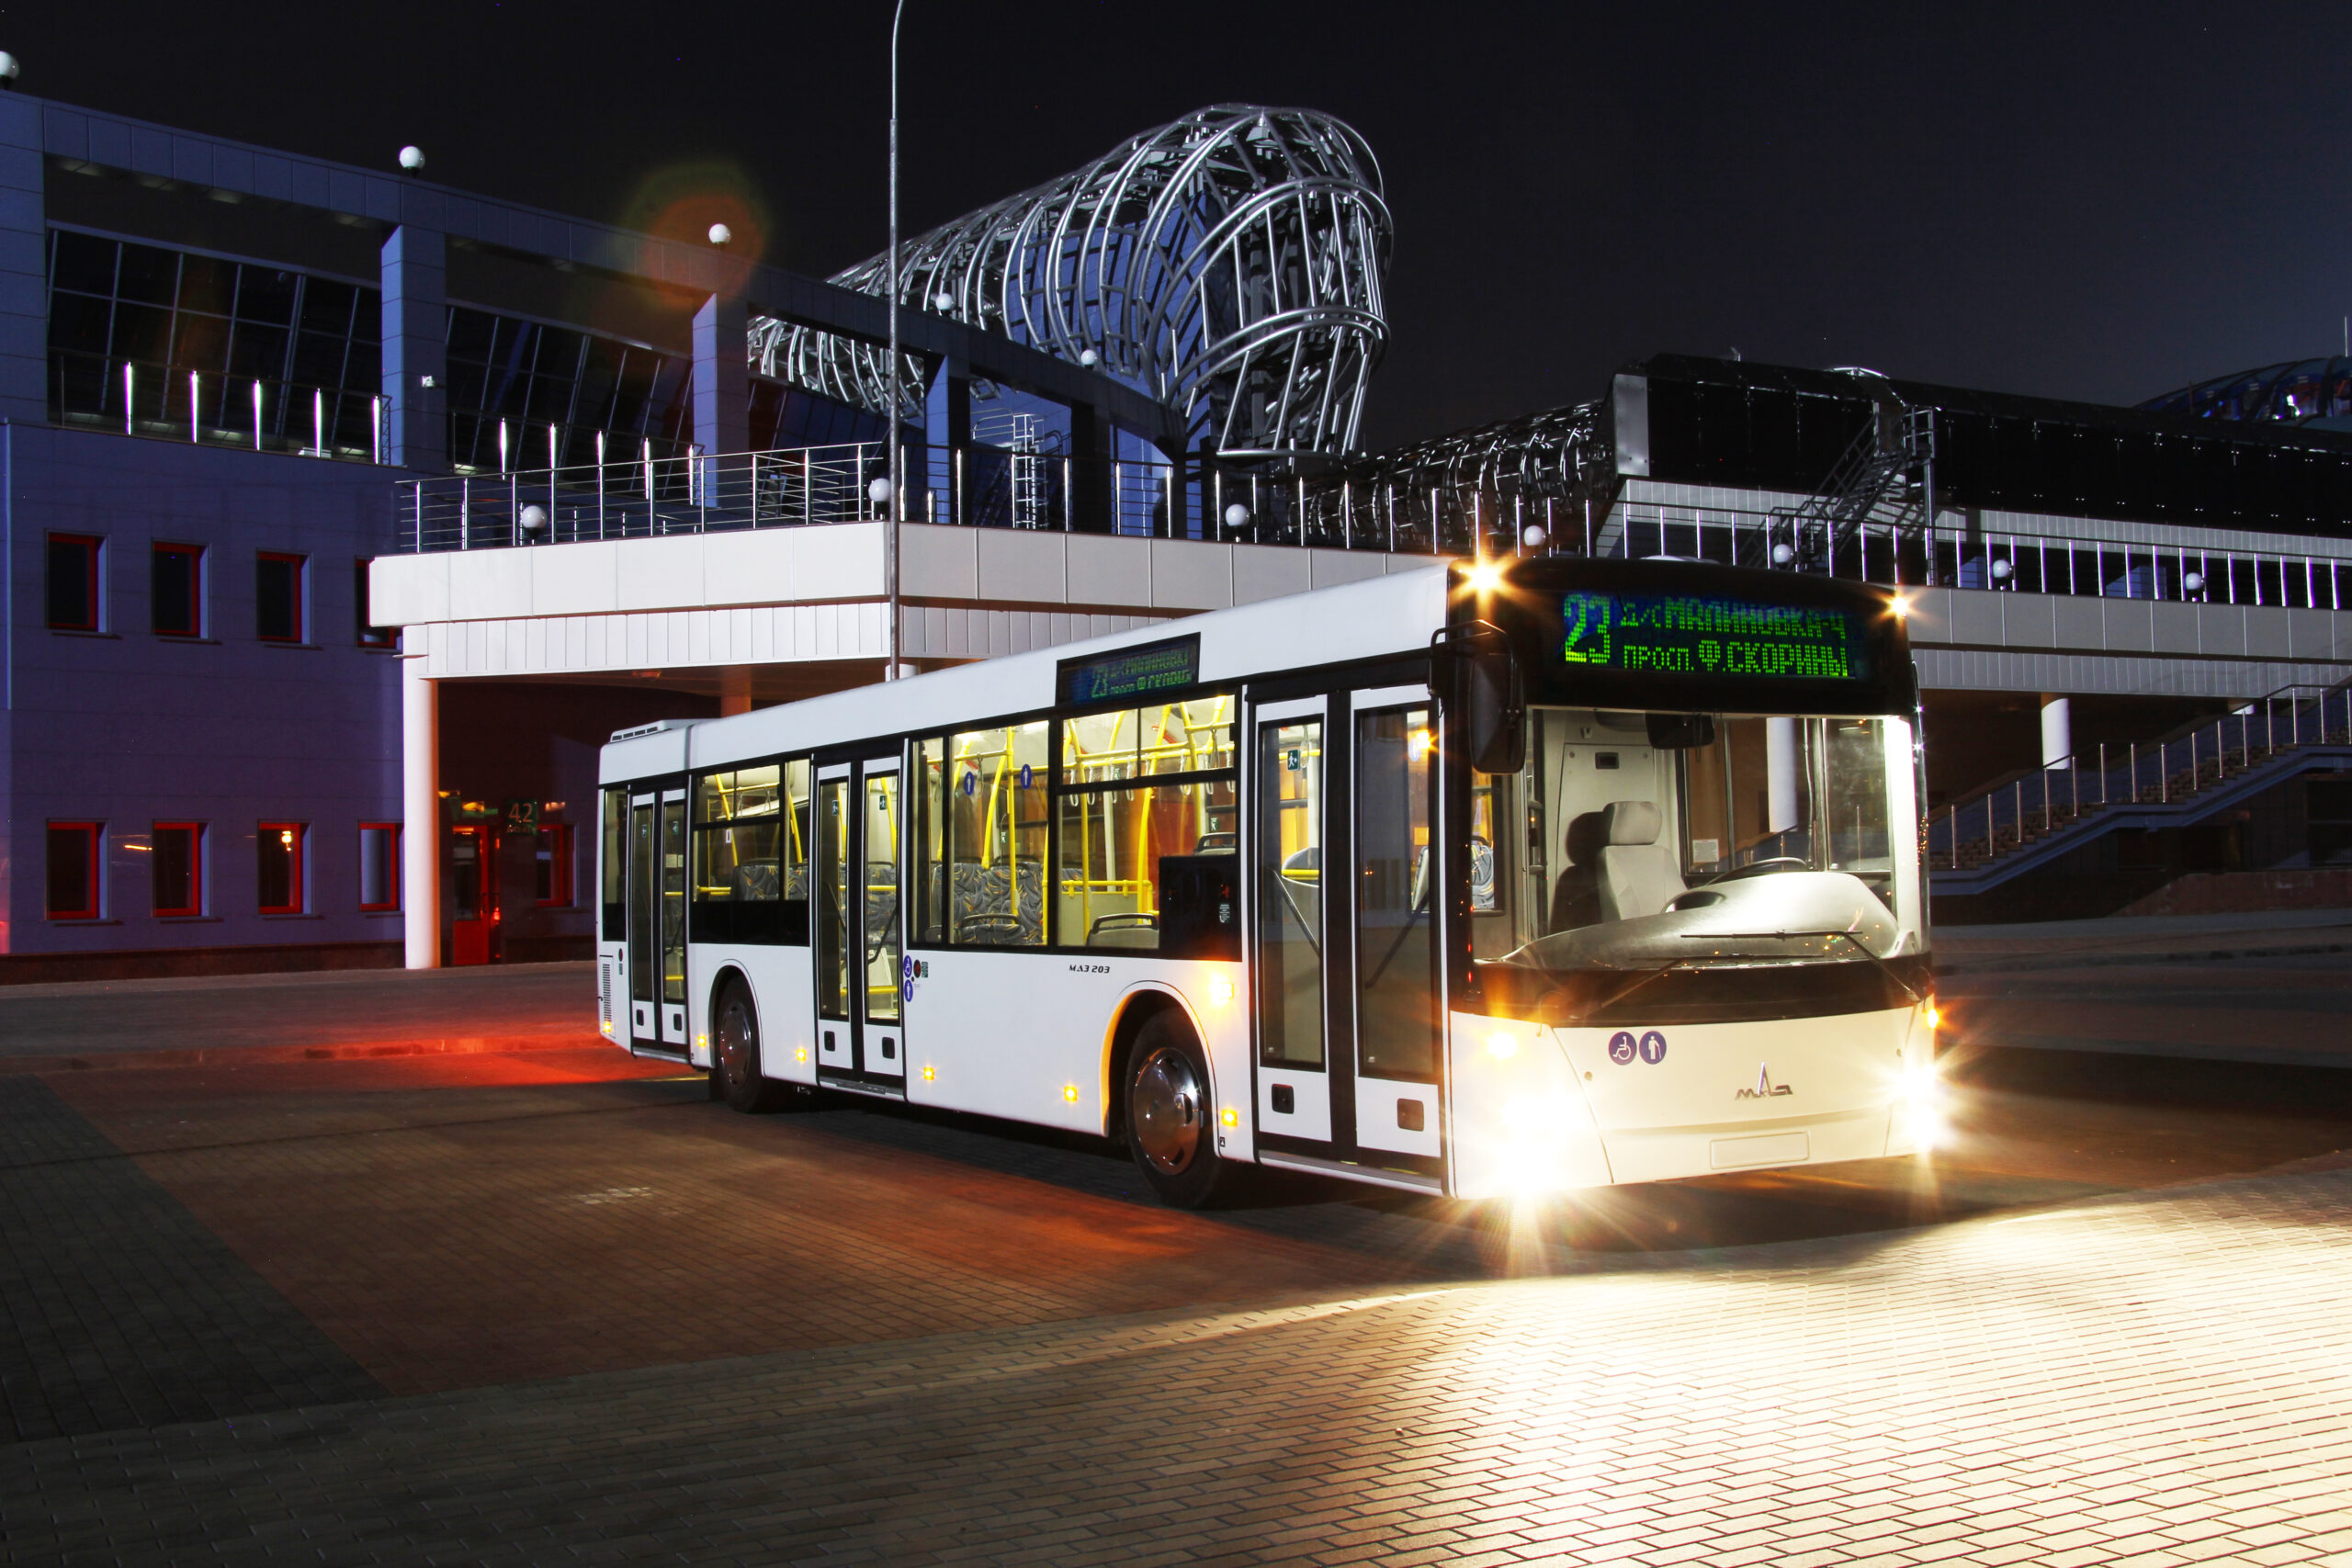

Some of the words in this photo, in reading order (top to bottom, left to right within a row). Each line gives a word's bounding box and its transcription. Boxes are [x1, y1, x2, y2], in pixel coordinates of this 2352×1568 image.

[1565, 594, 1610, 664] 23
[508, 802, 534, 823] 42
[1091, 964, 1111, 974] 203
